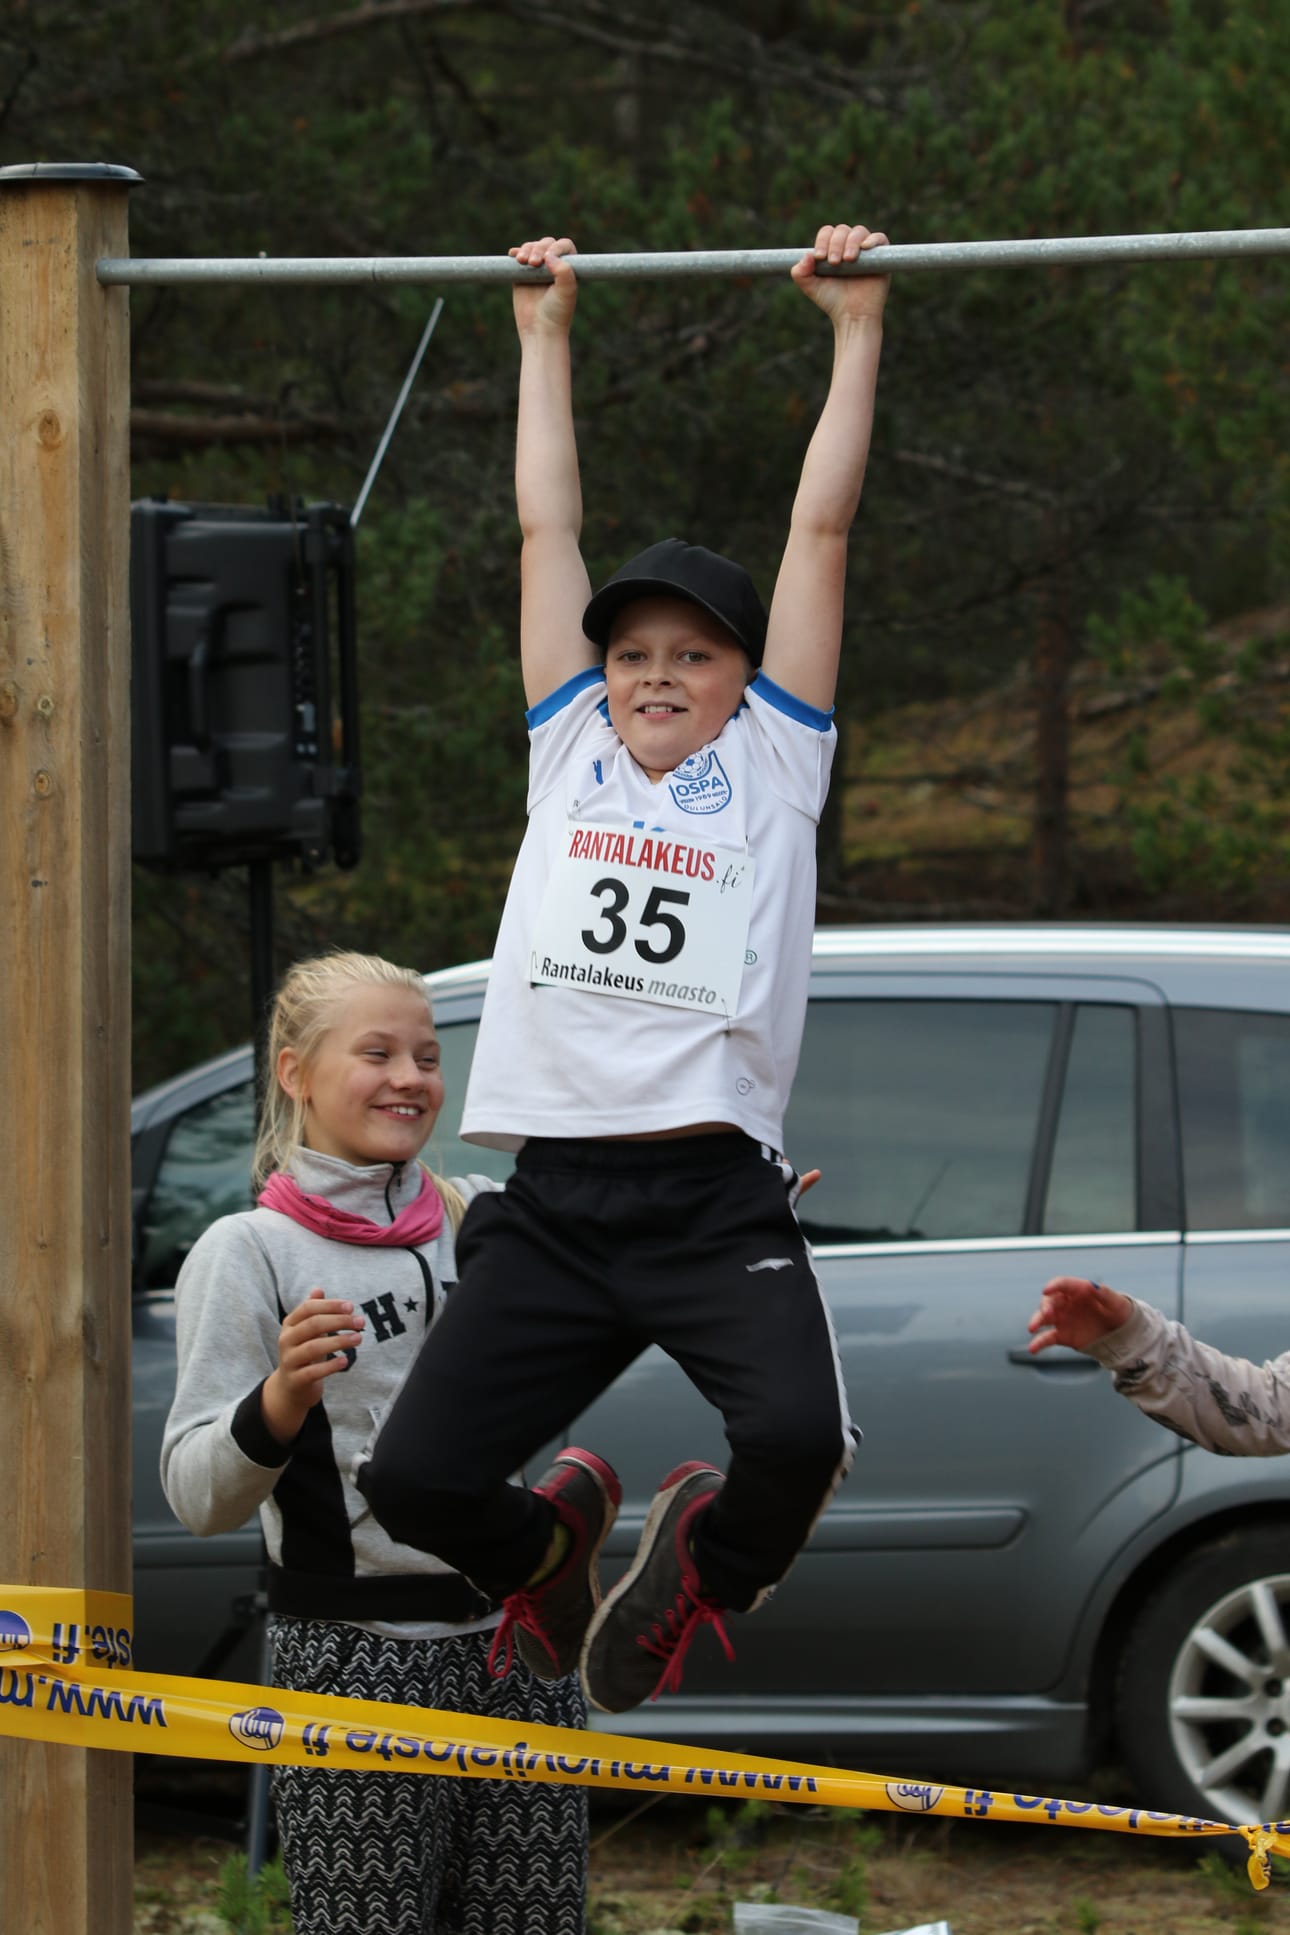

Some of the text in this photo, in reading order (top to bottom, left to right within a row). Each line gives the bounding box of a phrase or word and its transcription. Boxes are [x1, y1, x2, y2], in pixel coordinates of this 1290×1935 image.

[676, 776, 724, 796] OSPA
[581, 877, 691, 965] 35
[541, 957, 717, 1005] Rantalakeus maasto
